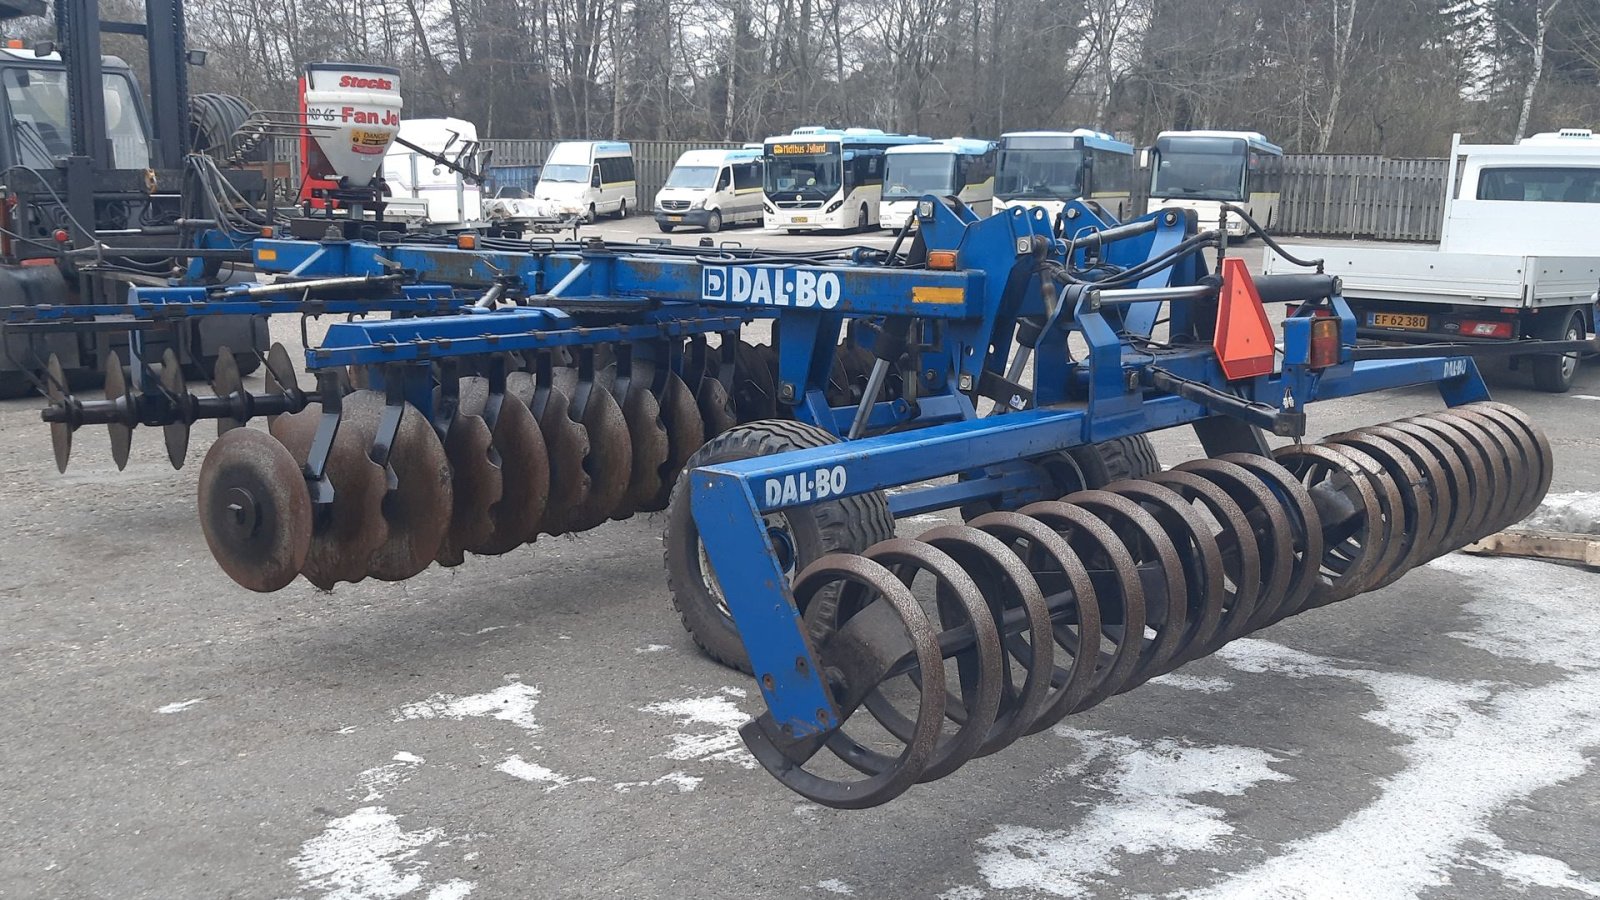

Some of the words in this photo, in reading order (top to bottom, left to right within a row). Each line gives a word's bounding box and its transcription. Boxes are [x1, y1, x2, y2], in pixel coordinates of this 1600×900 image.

[339, 75, 392, 90] Stocks
[342, 106, 379, 124] Fan
[1375, 315, 1387, 325] EF
[1391, 316, 1404, 326] 62
[1406, 317, 1426, 328] 380
